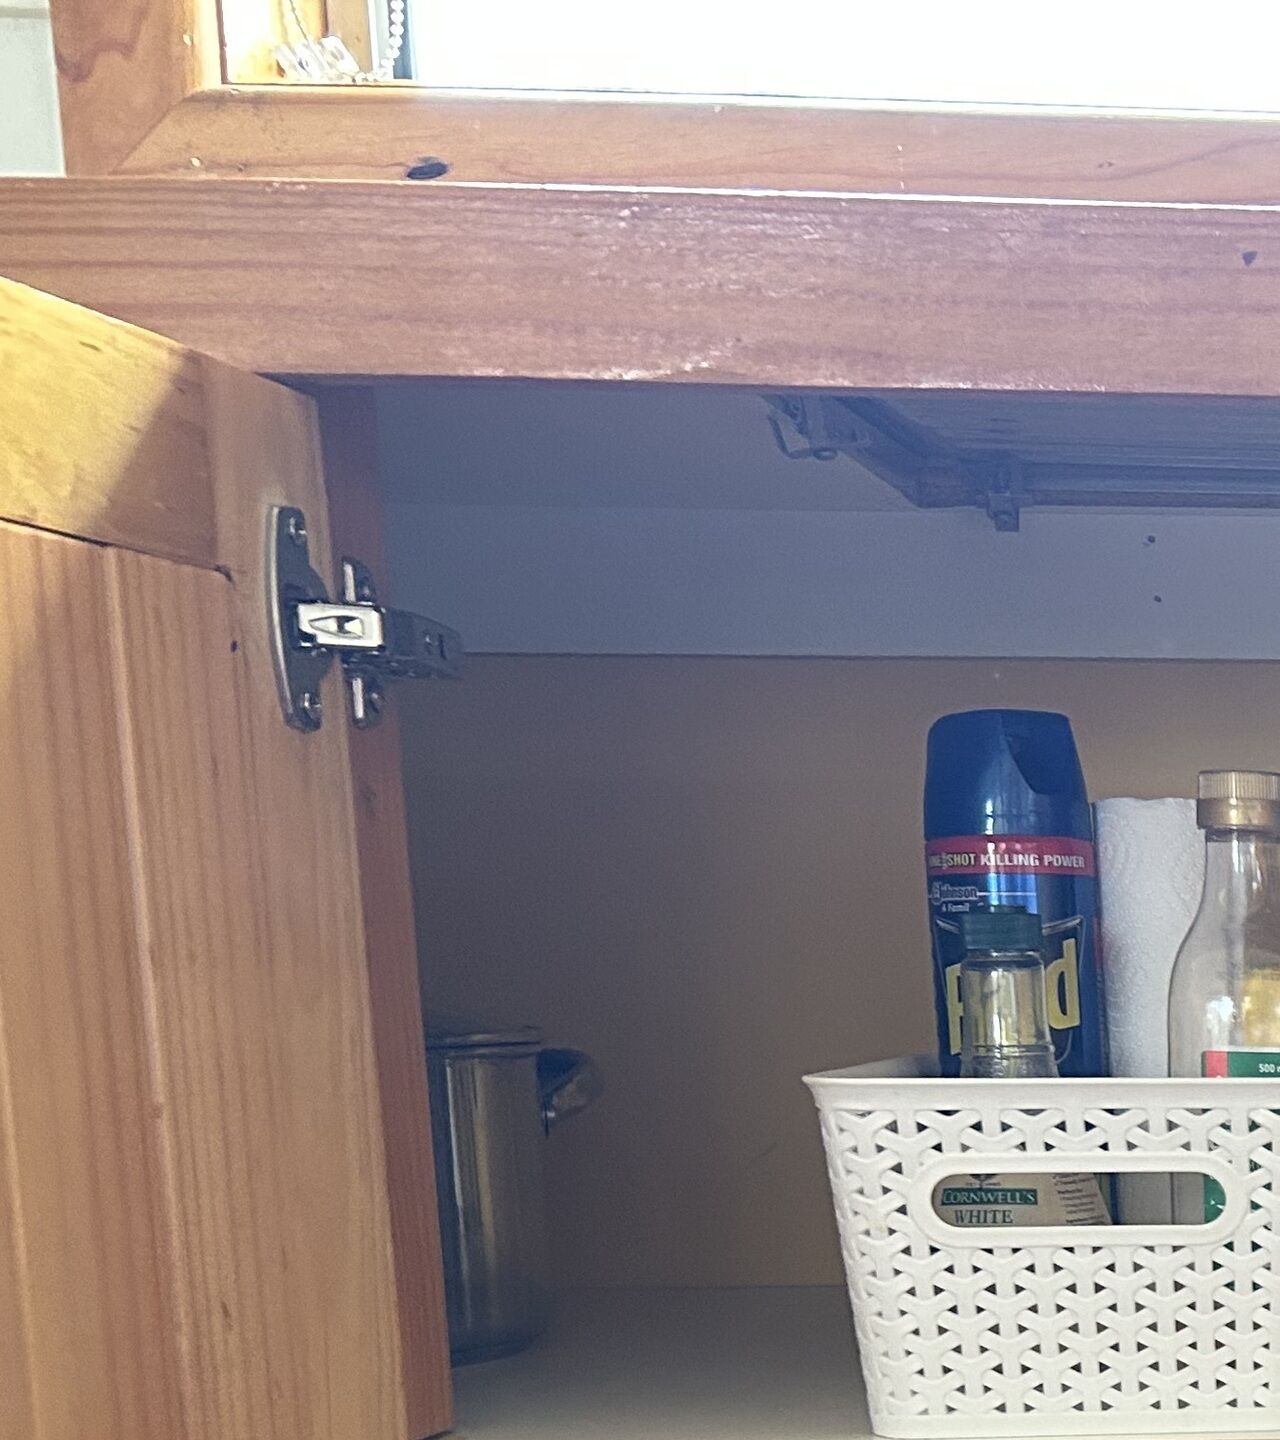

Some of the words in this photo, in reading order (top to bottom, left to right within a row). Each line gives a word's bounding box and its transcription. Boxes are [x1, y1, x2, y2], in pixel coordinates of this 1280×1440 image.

[947, 853, 976, 866] SHOT
[980, 853, 1039, 867] KILLING
[1043, 854, 1085, 868] POWER
[1258, 1063, 1275, 1073] 500
[943, 1190, 1036, 1204] CORNWELL'S
[953, 1209, 1014, 1225] WHITE
